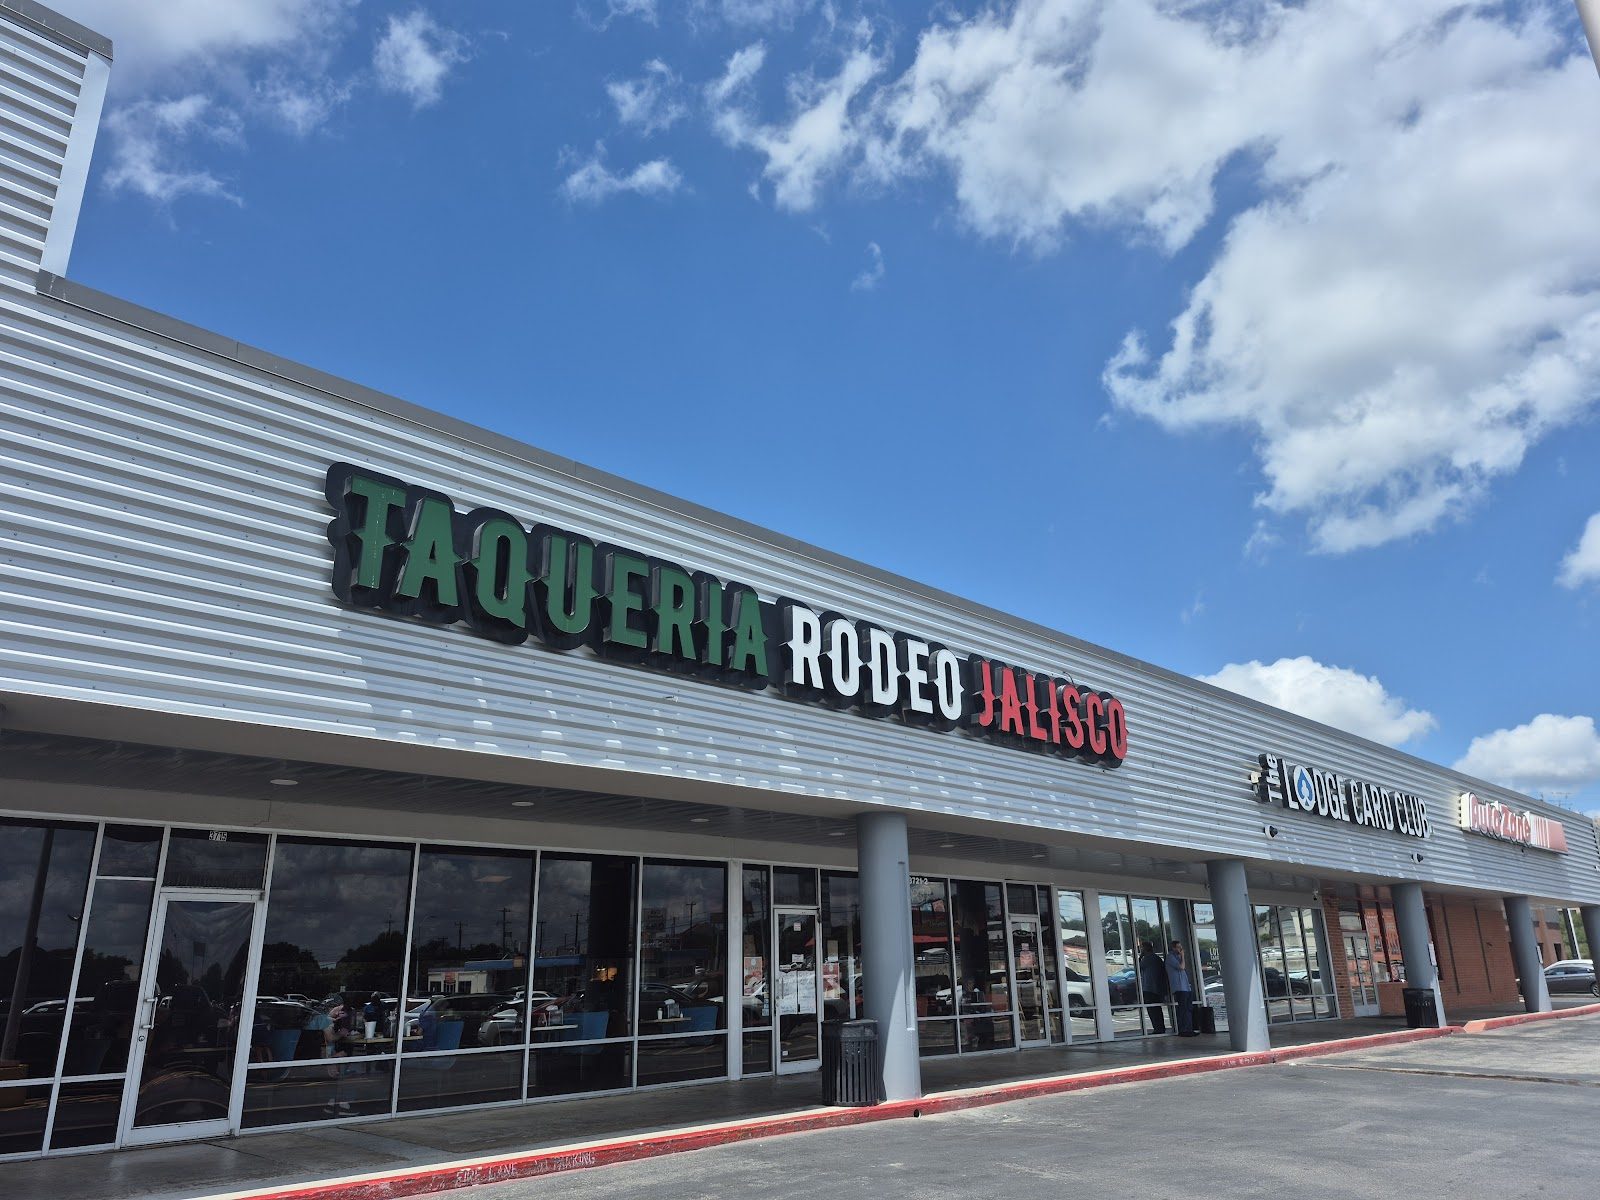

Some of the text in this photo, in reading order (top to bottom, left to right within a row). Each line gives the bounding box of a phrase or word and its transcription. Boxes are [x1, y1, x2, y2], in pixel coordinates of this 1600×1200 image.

[345, 475, 1130, 760] TAQUERIA RODEO JALISCO
[1266, 753, 1283, 802] The
[1282, 759, 1431, 839] LODGE CARD CLUB
[1469, 793, 1532, 843] AutoZone
